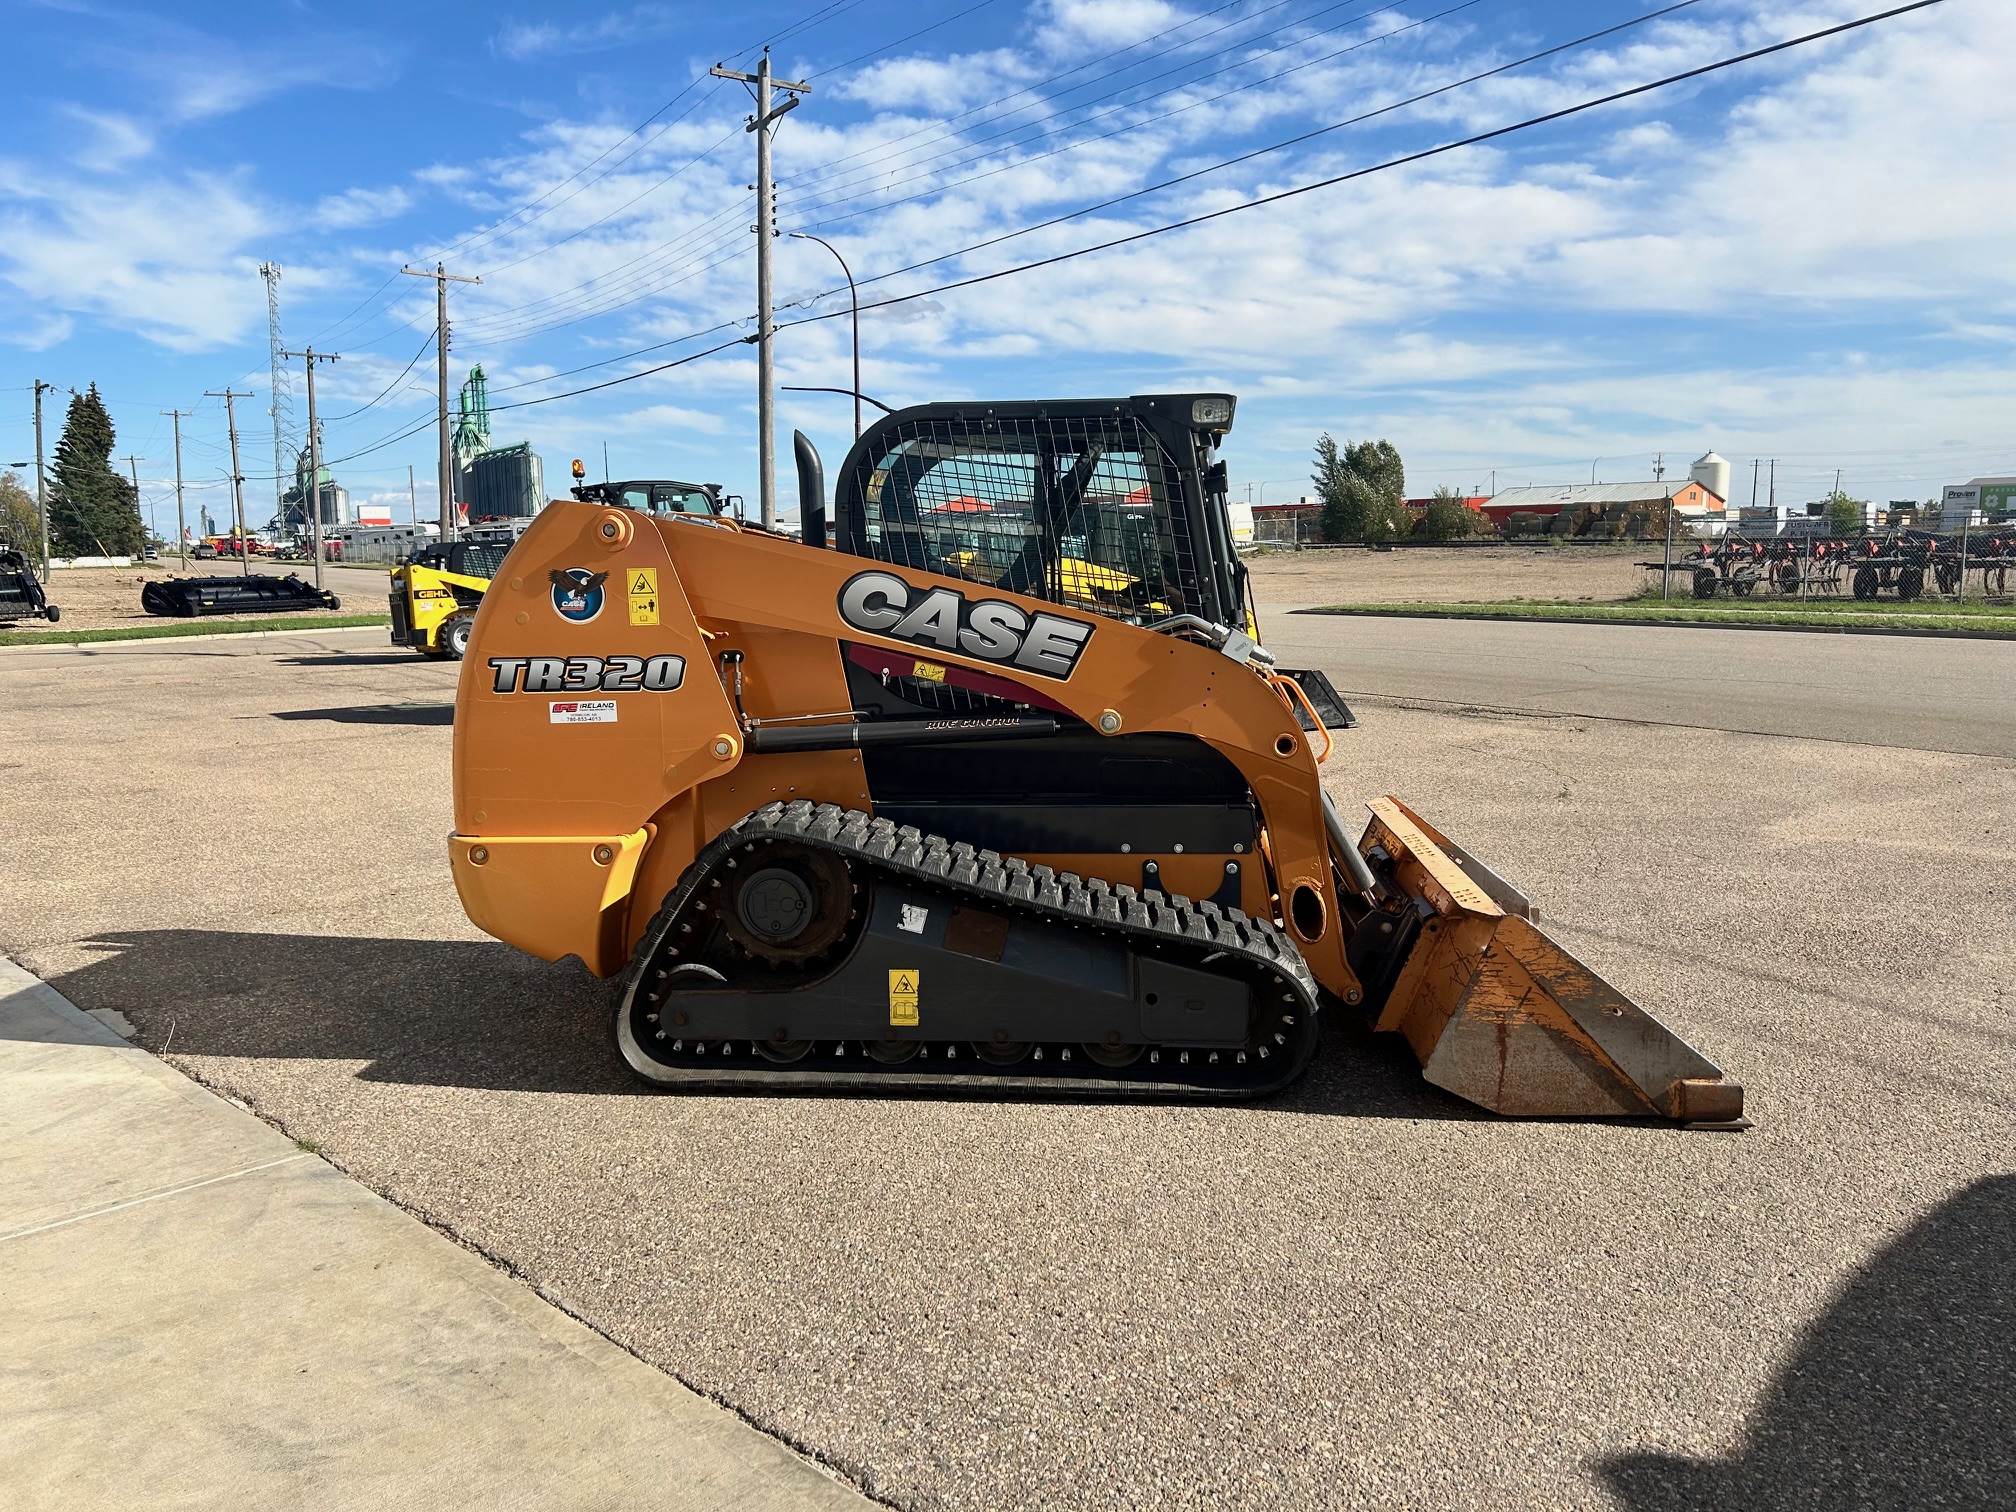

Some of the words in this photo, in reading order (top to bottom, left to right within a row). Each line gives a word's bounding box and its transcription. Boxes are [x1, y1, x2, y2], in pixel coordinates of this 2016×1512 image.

[418, 590, 448, 598] GEHL
[561, 600, 586, 608] CASE
[841, 574, 1092, 677] CASE
[488, 654, 687, 694] TR320
[925, 719, 959, 730] RIDE
[960, 717, 1020, 728] CONTROL
